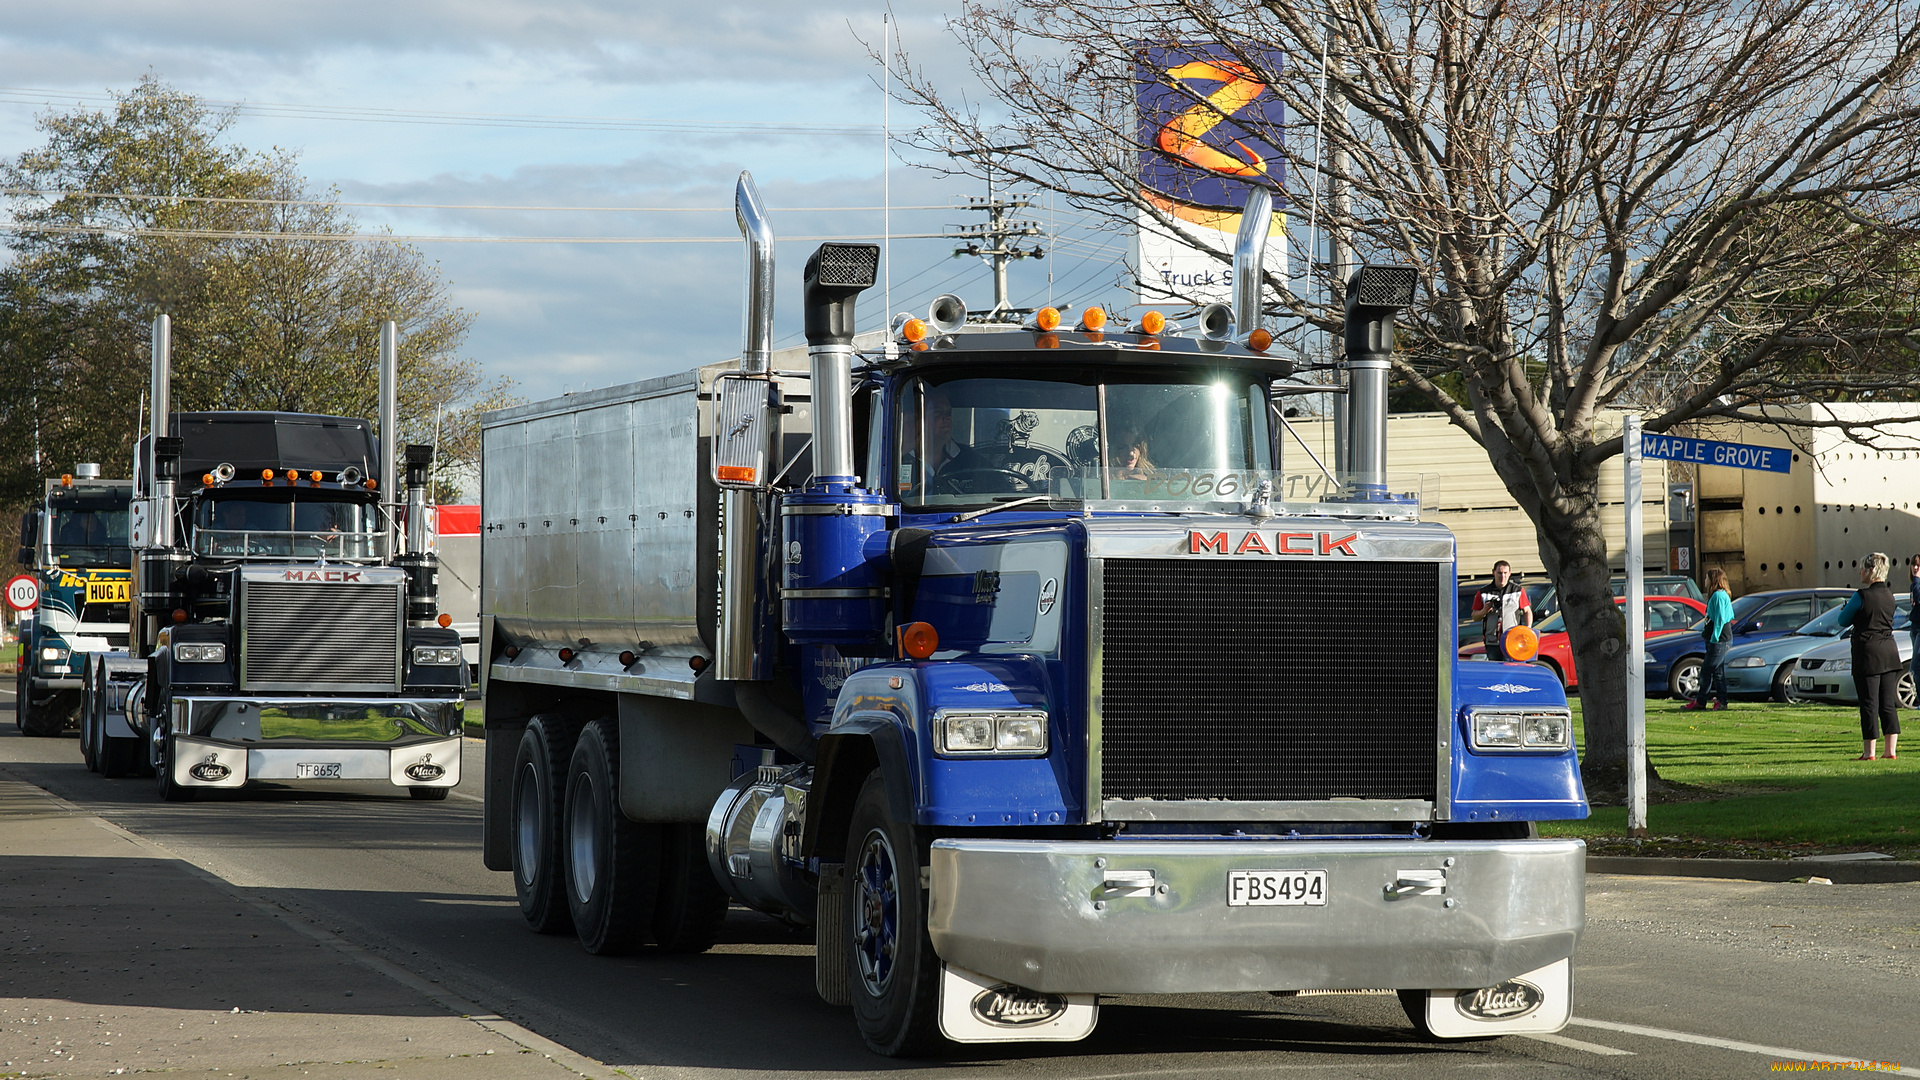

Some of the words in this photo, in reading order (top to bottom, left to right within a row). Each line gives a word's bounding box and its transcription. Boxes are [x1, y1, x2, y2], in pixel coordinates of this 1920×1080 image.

[1161, 269, 1215, 286] Truck
[1643, 436, 1706, 460] MAPLE
[1713, 445, 1772, 469] GROVE
[1143, 472, 1259, 497] DOGGY
[1269, 474, 1357, 499] STYLE
[1188, 530, 1361, 557] MACK
[285, 570, 361, 582] MACK
[12, 586, 35, 600] 100
[91, 584, 113, 600] HUG
[118, 584, 125, 600] A
[197, 765, 225, 777] Mack
[299, 764, 340, 777] TF8652
[411, 765, 439, 777] Mack
[1233, 876, 1322, 900] FBS494
[986, 992, 1051, 1016] Mack
[1469, 986, 1529, 1011] Mack
